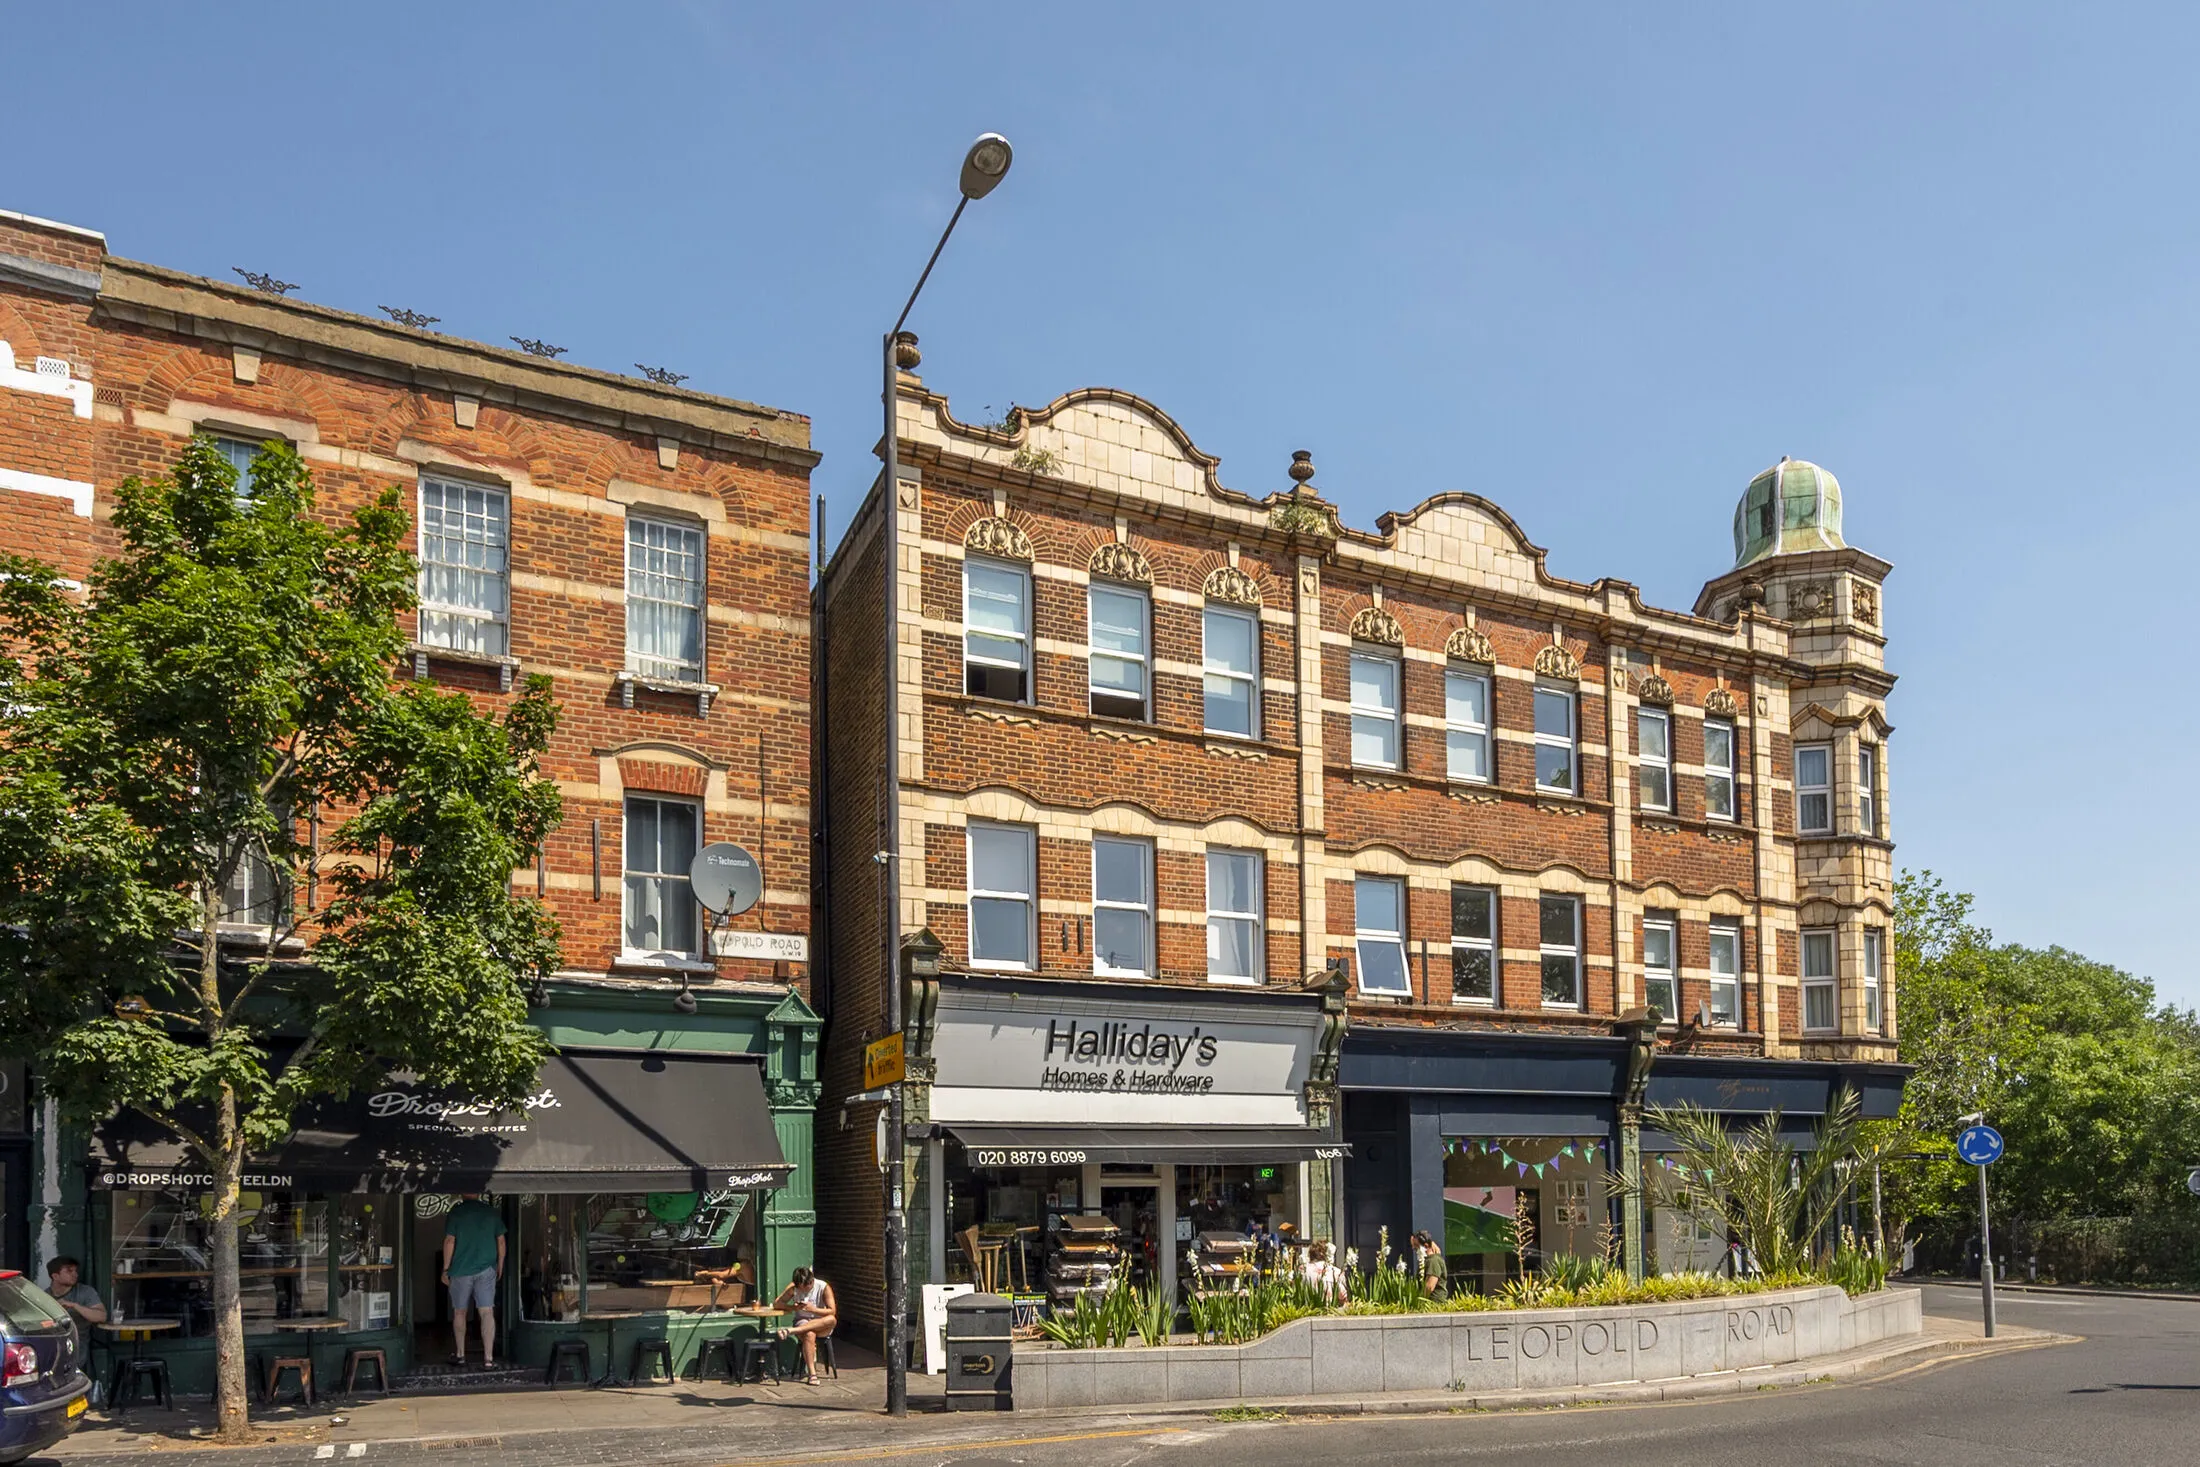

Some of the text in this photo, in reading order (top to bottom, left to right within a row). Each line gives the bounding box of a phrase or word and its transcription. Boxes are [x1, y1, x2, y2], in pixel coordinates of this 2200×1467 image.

[771, 938, 801, 950] ROAD
[1048, 1019, 1217, 1070] Halliday's
[1044, 1066, 1214, 1089] Homes & Hardware
[408, 1123, 528, 1132] SPECIALTY COFFEE
[978, 1151, 1087, 1164] 020 8879 6099
[1261, 1168, 1274, 1178] KEY
[103, 1173, 292, 1187] @DROPSHOTCEELDN
[1466, 1306, 1794, 1361] LEOPOLD ROAD
